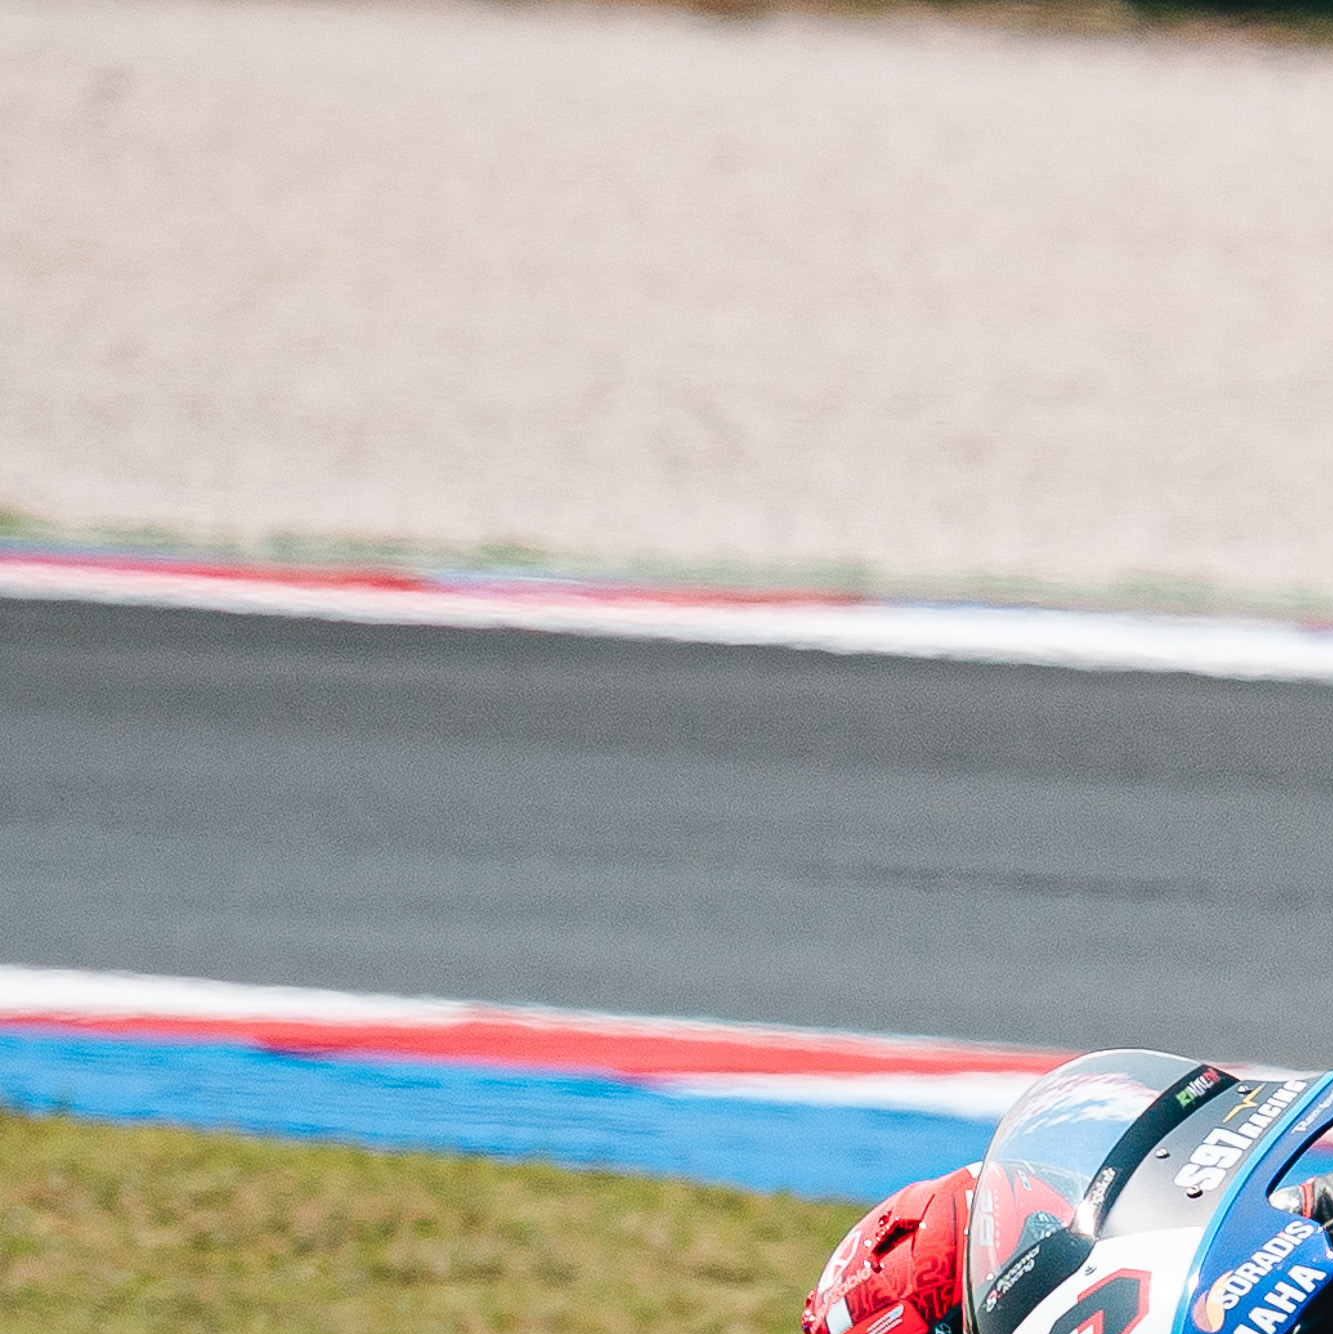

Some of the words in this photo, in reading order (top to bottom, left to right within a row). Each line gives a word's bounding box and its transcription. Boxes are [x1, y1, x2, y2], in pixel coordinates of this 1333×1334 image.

[1174, 1126, 1253, 1191] S97
[1238, 1079, 1308, 1139] RACING
[1213, 1219, 1315, 1311] SORADIS
